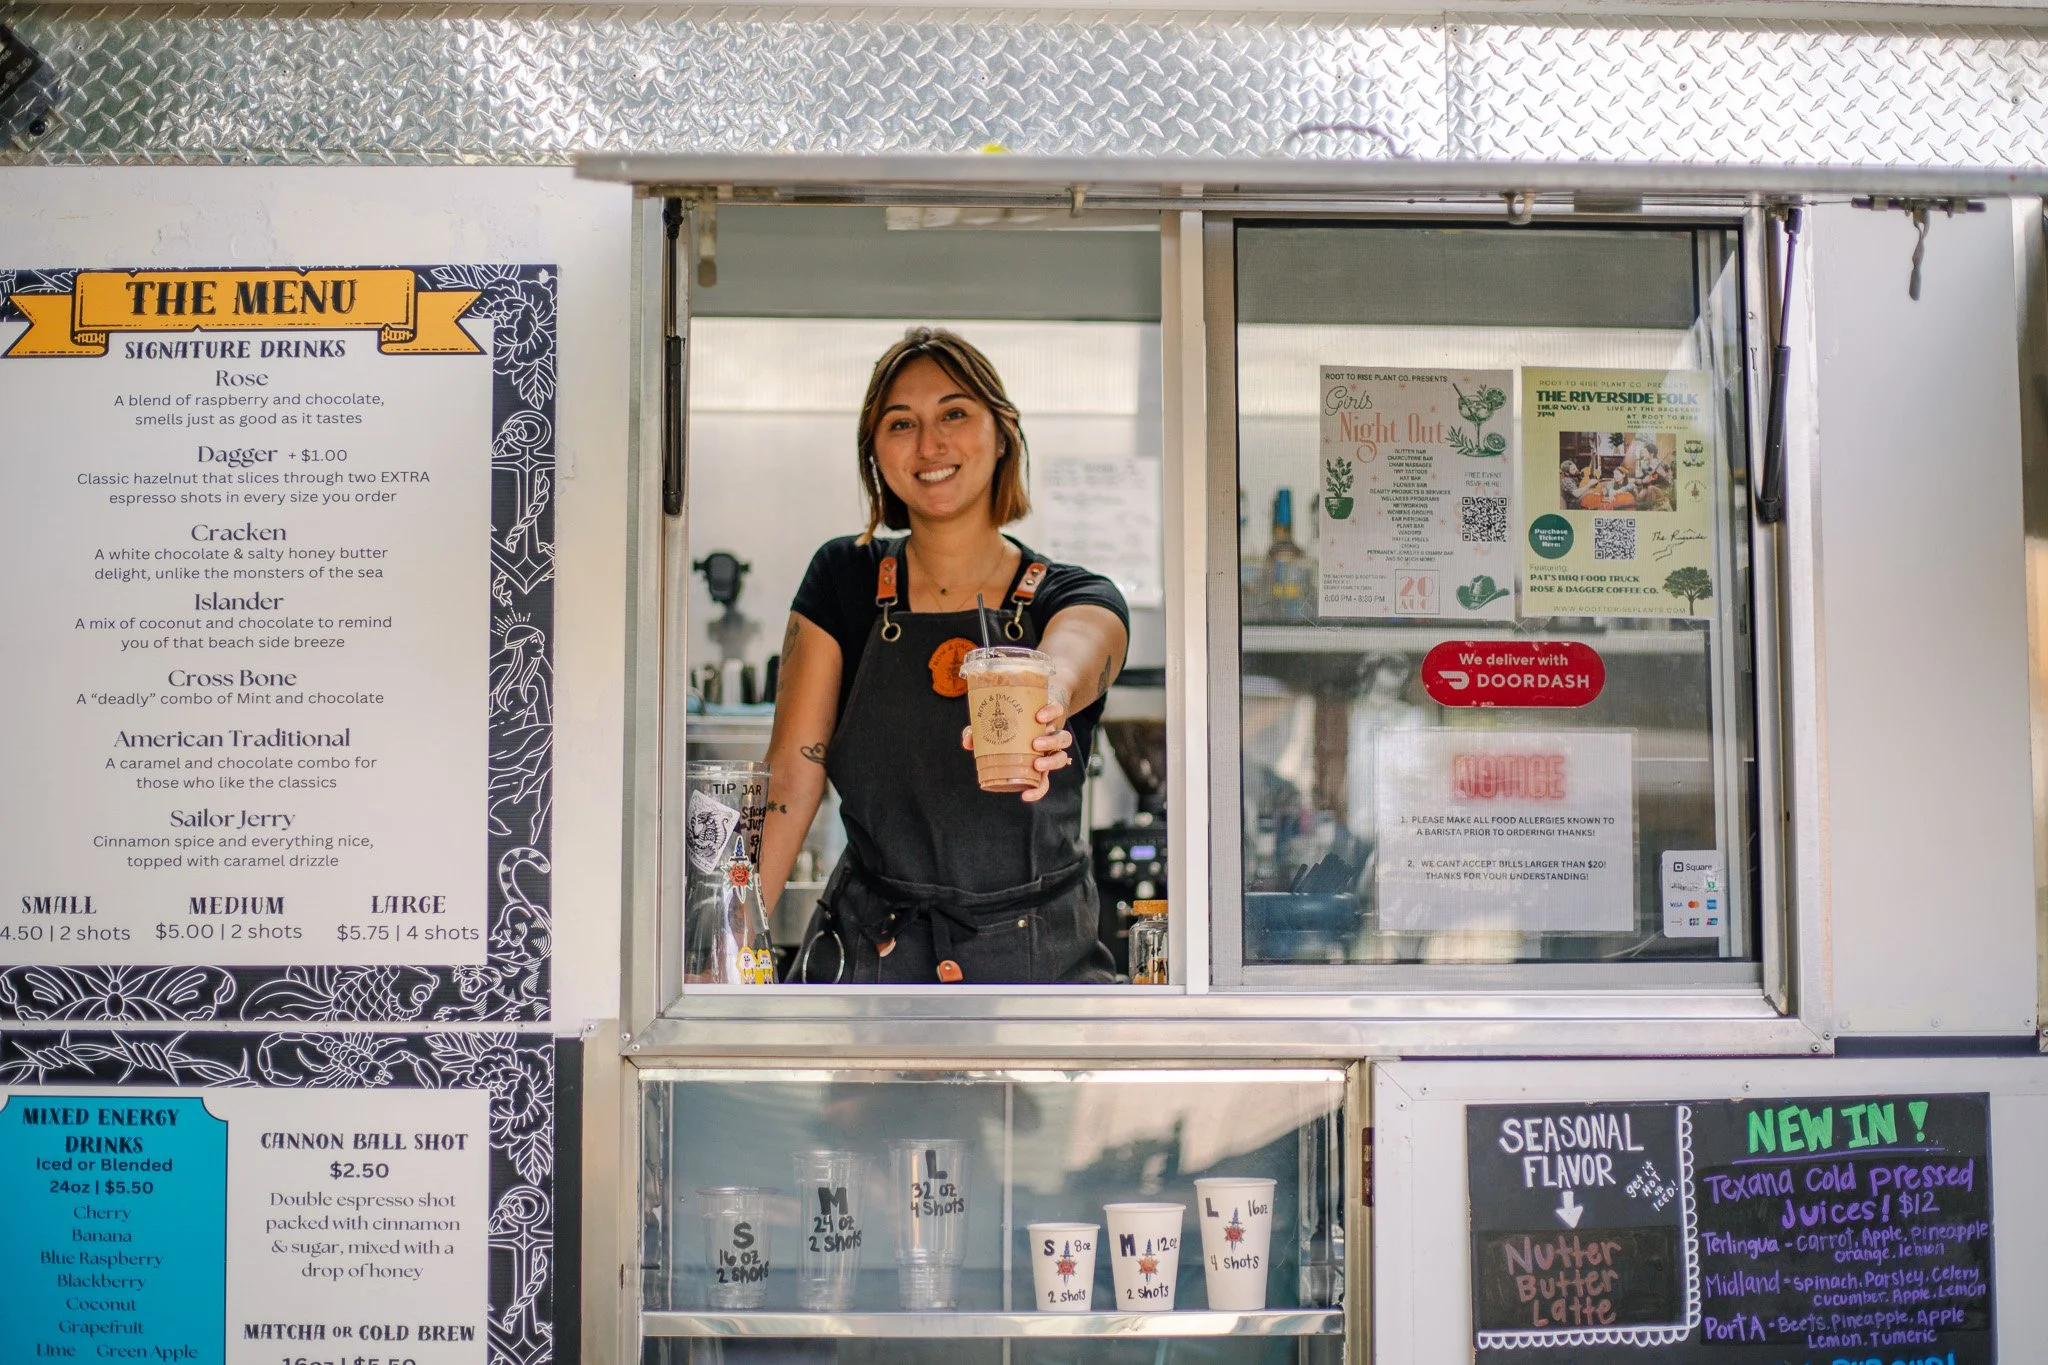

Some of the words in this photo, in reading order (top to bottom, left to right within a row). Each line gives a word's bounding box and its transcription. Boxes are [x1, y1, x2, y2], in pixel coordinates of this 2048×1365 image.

[126, 280, 217, 316] THE
[233, 279, 356, 315] MENU
[126, 341, 250, 359] SIGNATURE
[261, 340, 345, 357] DRINKS
[217, 371, 268, 386] Rose
[1325, 386, 1372, 416] Girls
[1537, 391, 1566, 402] THE
[1570, 391, 1654, 404] RIVERSIDE
[1657, 393, 1699, 404] FOLK
[1340, 412, 1400, 463] Night
[1408, 413, 1445, 444] Out
[199, 446, 277, 468] Dagger
[302, 449, 347, 463] $1.00
[192, 522, 286, 541] Cracken
[1400, 576, 1434, 597] 20
[196, 592, 283, 610] Islander
[1459, 653, 1482, 665] We
[1486, 653, 1534, 665] deliver
[1538, 654, 1568, 665] with
[168, 670, 233, 686] Cross
[240, 670, 296, 686] Bone
[1478, 674, 1589, 688] DOORDASH
[115, 731, 222, 747] American
[229, 728, 349, 746] Traditional
[1453, 755, 1565, 799] NOTICE
[713, 784, 736, 794] TIP
[742, 785, 761, 795] JAR
[171, 808, 234, 827] Sailor
[237, 810, 296, 830] Jerry
[1421, 860, 1435, 868] WE
[1436, 860, 1460, 868] CANT
[1463, 860, 1496, 868] ACCEPT
[1499, 860, 1523, 868] BILLS
[1525, 860, 1559, 868] LARGER
[1561, 860, 1585, 868] THAN
[1426, 872, 1461, 880] THANKS
[1464, 872, 1481, 880] FOR
[1483, 872, 1507, 880] YOUR
[1510, 872, 1588, 880] UNDERSTANDING!
[22, 896, 96, 914] SMALL
[190, 897, 283, 914] MEDIUM
[372, 896, 445, 913] LARGE
[156, 922, 213, 940] $5.00
[232, 924, 241, 938] 2
[248, 924, 302, 938] shots
[23, 1108, 88, 1124] MIXED
[99, 1109, 178, 1125] ENERGY
[1500, 1114, 1644, 1153] SEASONAL
[1749, 1105, 1832, 1153] NEW
[66, 1137, 142, 1153] DRINKS
[261, 1133, 343, 1149] CANNON
[354, 1134, 406, 1149] BALL
[415, 1134, 468, 1150] SHOT
[330, 1161, 389, 1179] $2.50
[925, 1150, 948, 1179] L
[1524, 1154, 1616, 1188] FLAVOR
[50, 1181, 89, 1193] 24oz
[105, 1180, 153, 1195] $5.50
[912, 1181, 934, 1199] 32
[940, 1184, 957, 1197] oz
[1626, 1173, 1644, 1197] get
[1642, 1171, 1662, 1196] HOT
[1703, 1169, 1794, 1204] Texana
[818, 1187, 848, 1215] M
[1653, 1180, 1678, 1211] ICED!
[1899, 1191, 1940, 1218] $12
[74, 1205, 128, 1222] Cherry
[814, 1216, 833, 1233] 24
[839, 1216, 855, 1231] oz
[73, 1229, 131, 1242] Banana
[733, 1222, 754, 1248] S
[1157, 1239, 1177, 1251] 12oz
[1701, 1232, 1780, 1259] Terlingua
[41, 1250, 74, 1264] Blue
[80, 1252, 162, 1269] Raspberry
[719, 1249, 736, 1266] 16
[741, 1250, 760, 1265] oz
[1504, 1236, 1622, 1275] Nutter
[58, 1273, 143, 1291] Blackberry
[716, 1269, 728, 1284] 2
[1515, 1269, 1619, 1301] Butter
[1705, 1269, 1780, 1298] Midland
[66, 1298, 135, 1311] Coconut
[1533, 1296, 1616, 1327] Latte
[59, 1320, 142, 1337] Grapefruit
[245, 1324, 325, 1340] MATCHA
[333, 1327, 352, 1337] OR
[359, 1325, 408, 1340] COLD
[418, 1326, 475, 1341] BREW
[1750, 1315, 1766, 1341] A
[37, 1343, 75, 1356] Lime
[97, 1346, 148, 1357] Green
[152, 1345, 197, 1362] Apple
